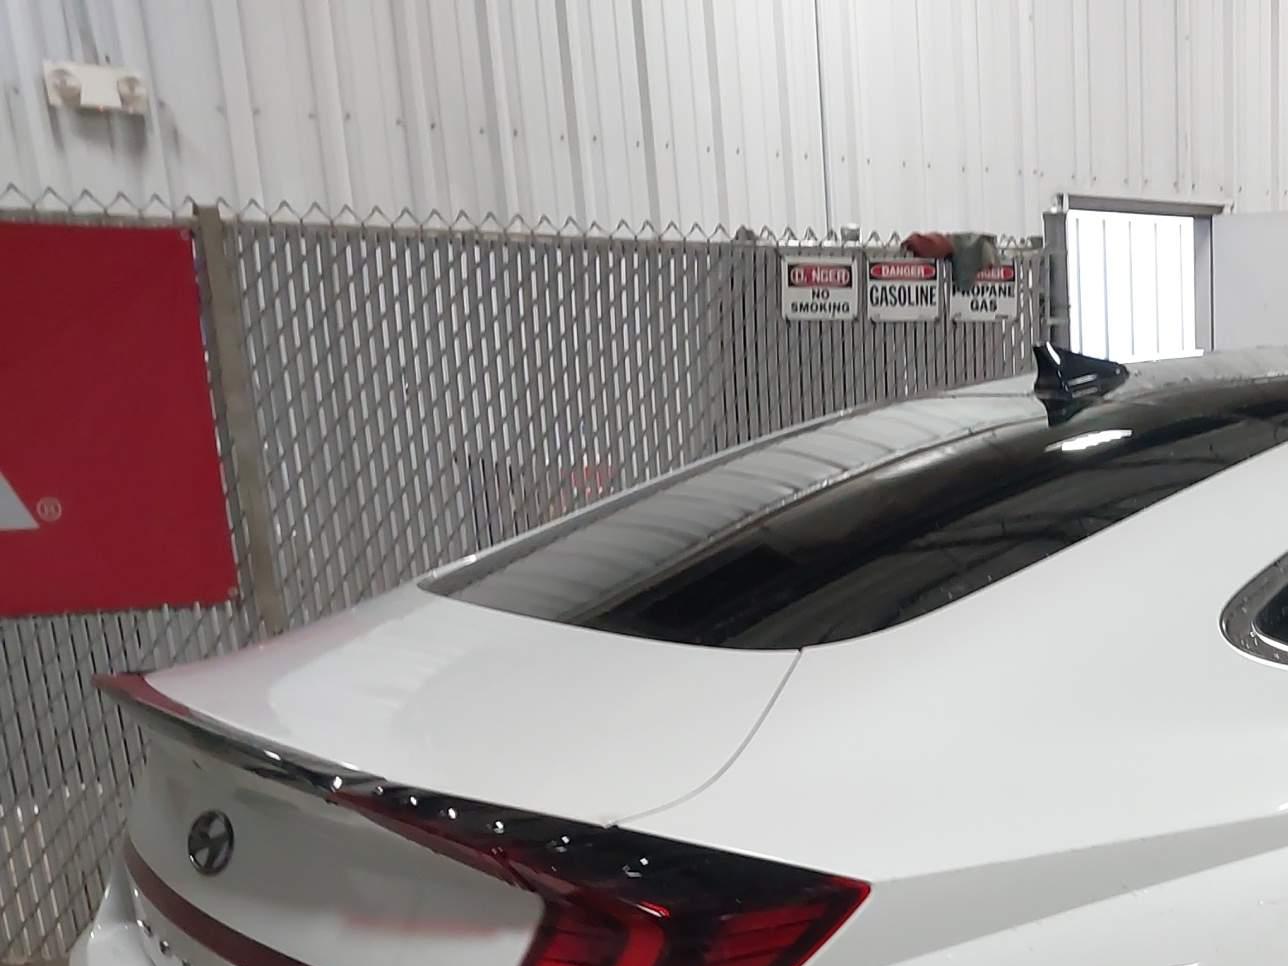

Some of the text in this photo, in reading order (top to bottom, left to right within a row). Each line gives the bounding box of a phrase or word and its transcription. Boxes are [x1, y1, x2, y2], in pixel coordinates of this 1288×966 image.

[881, 264, 925, 278] DANGER
[812, 288, 830, 300] NO
[869, 285, 937, 307] GASOLINE
[791, 302, 850, 313] SMOKING
[970, 299, 998, 313] GAS
